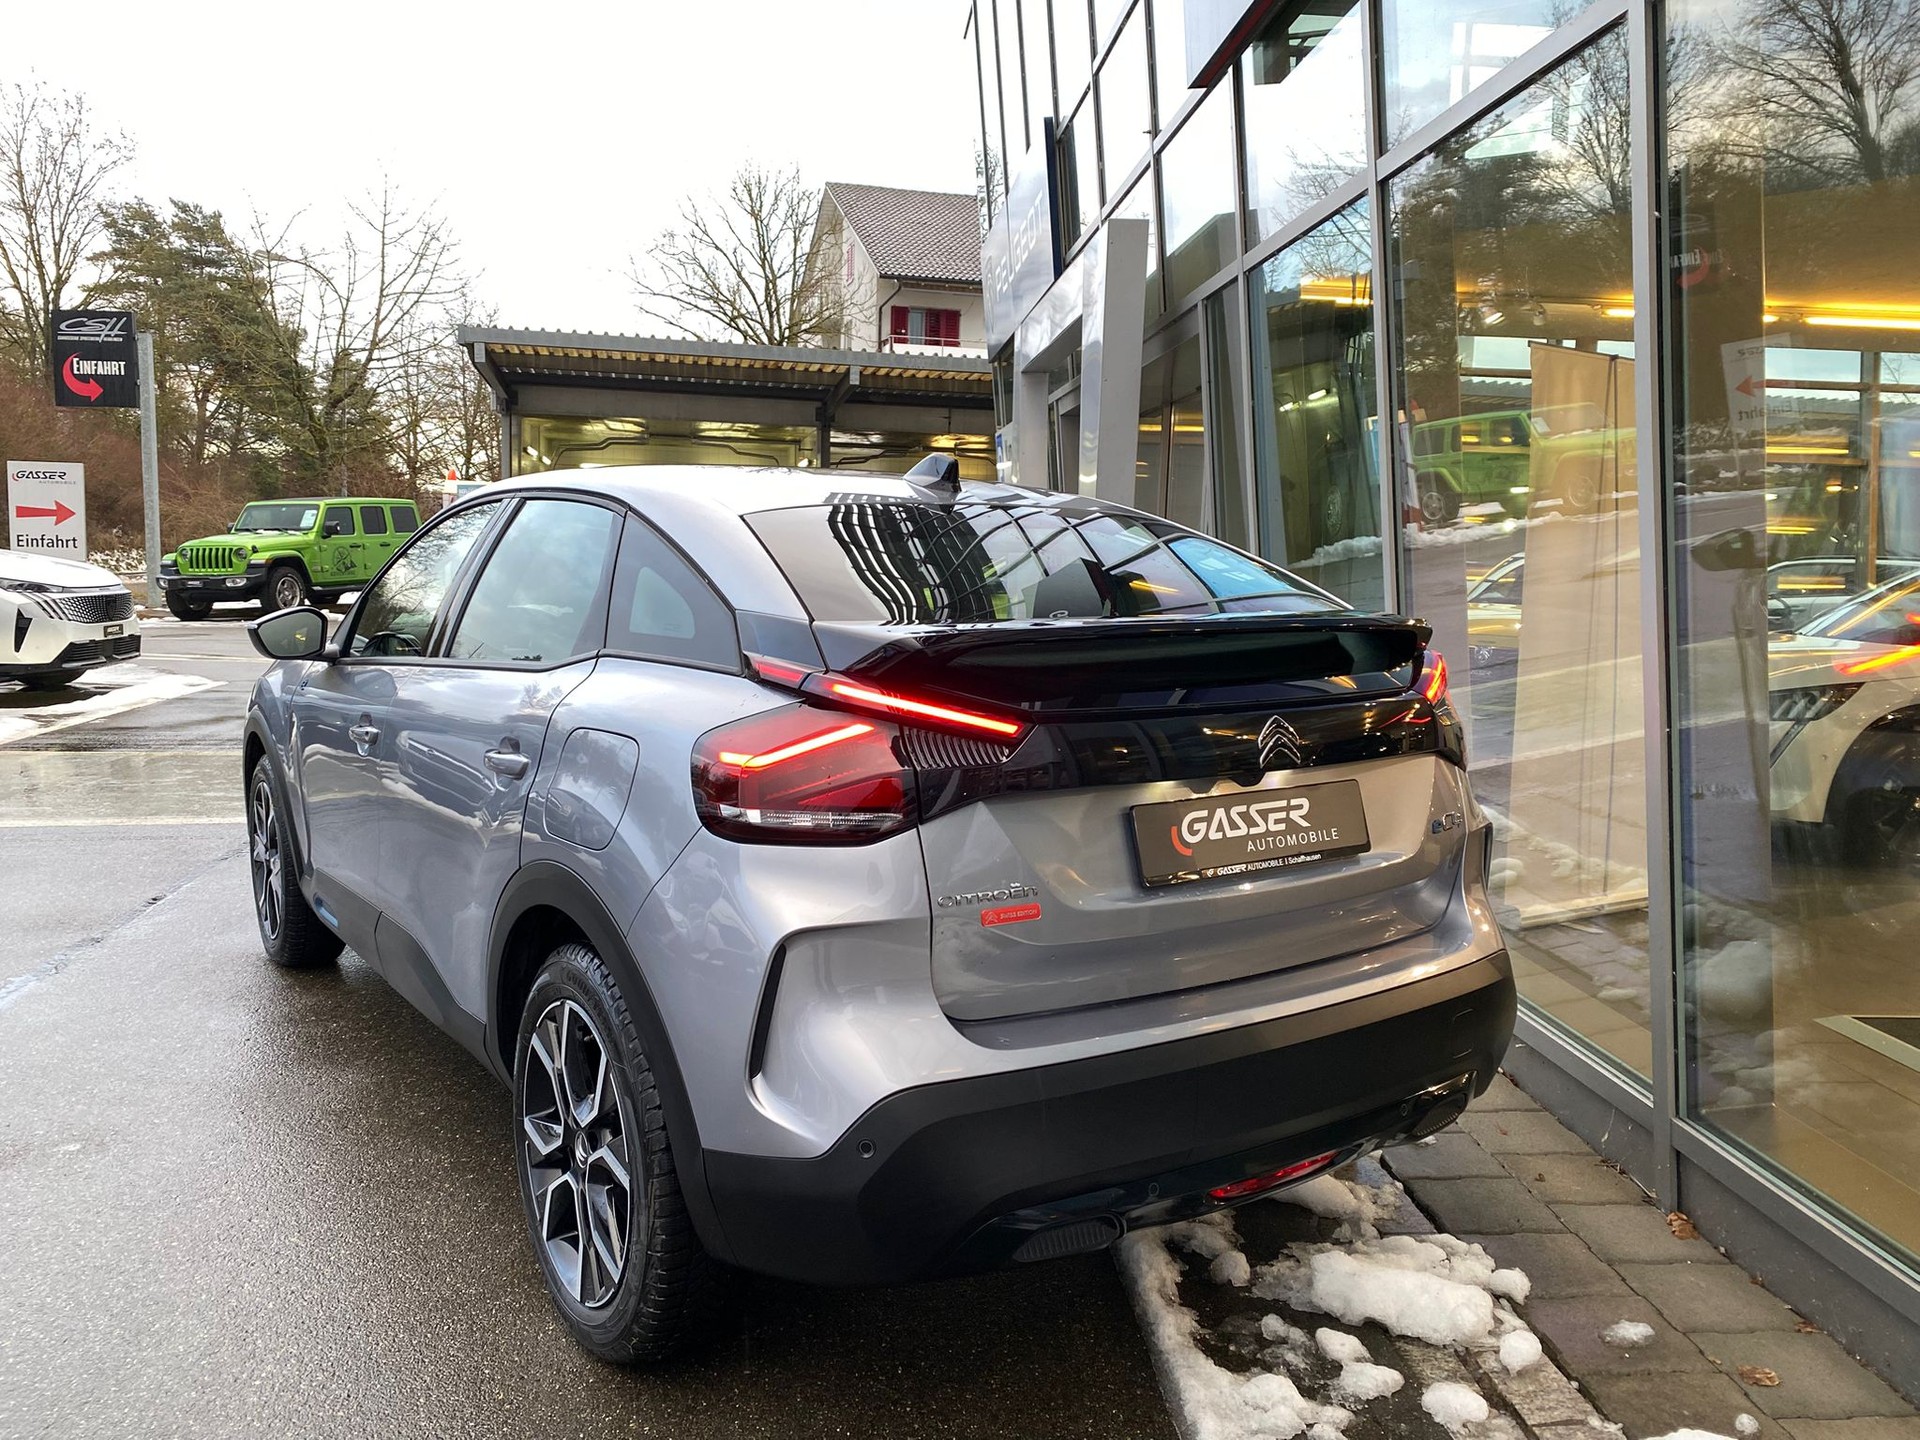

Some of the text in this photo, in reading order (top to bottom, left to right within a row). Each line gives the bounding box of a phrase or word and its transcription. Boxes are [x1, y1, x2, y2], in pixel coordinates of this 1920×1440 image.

[995, 189, 1043, 302] PEUGEOT
[72, 357, 126, 376] EINFAHRT
[16, 470, 67, 481] GASSER
[16, 534, 78, 549] Einfahrt
[1181, 797, 1312, 844] GASSER
[1247, 827, 1340, 853] AUTOMOBILE
[1216, 864, 1248, 876] GASSER
[1247, 858, 1284, 871] AUTOMOBILE
[1288, 854, 1322, 865] Schaffhausen
